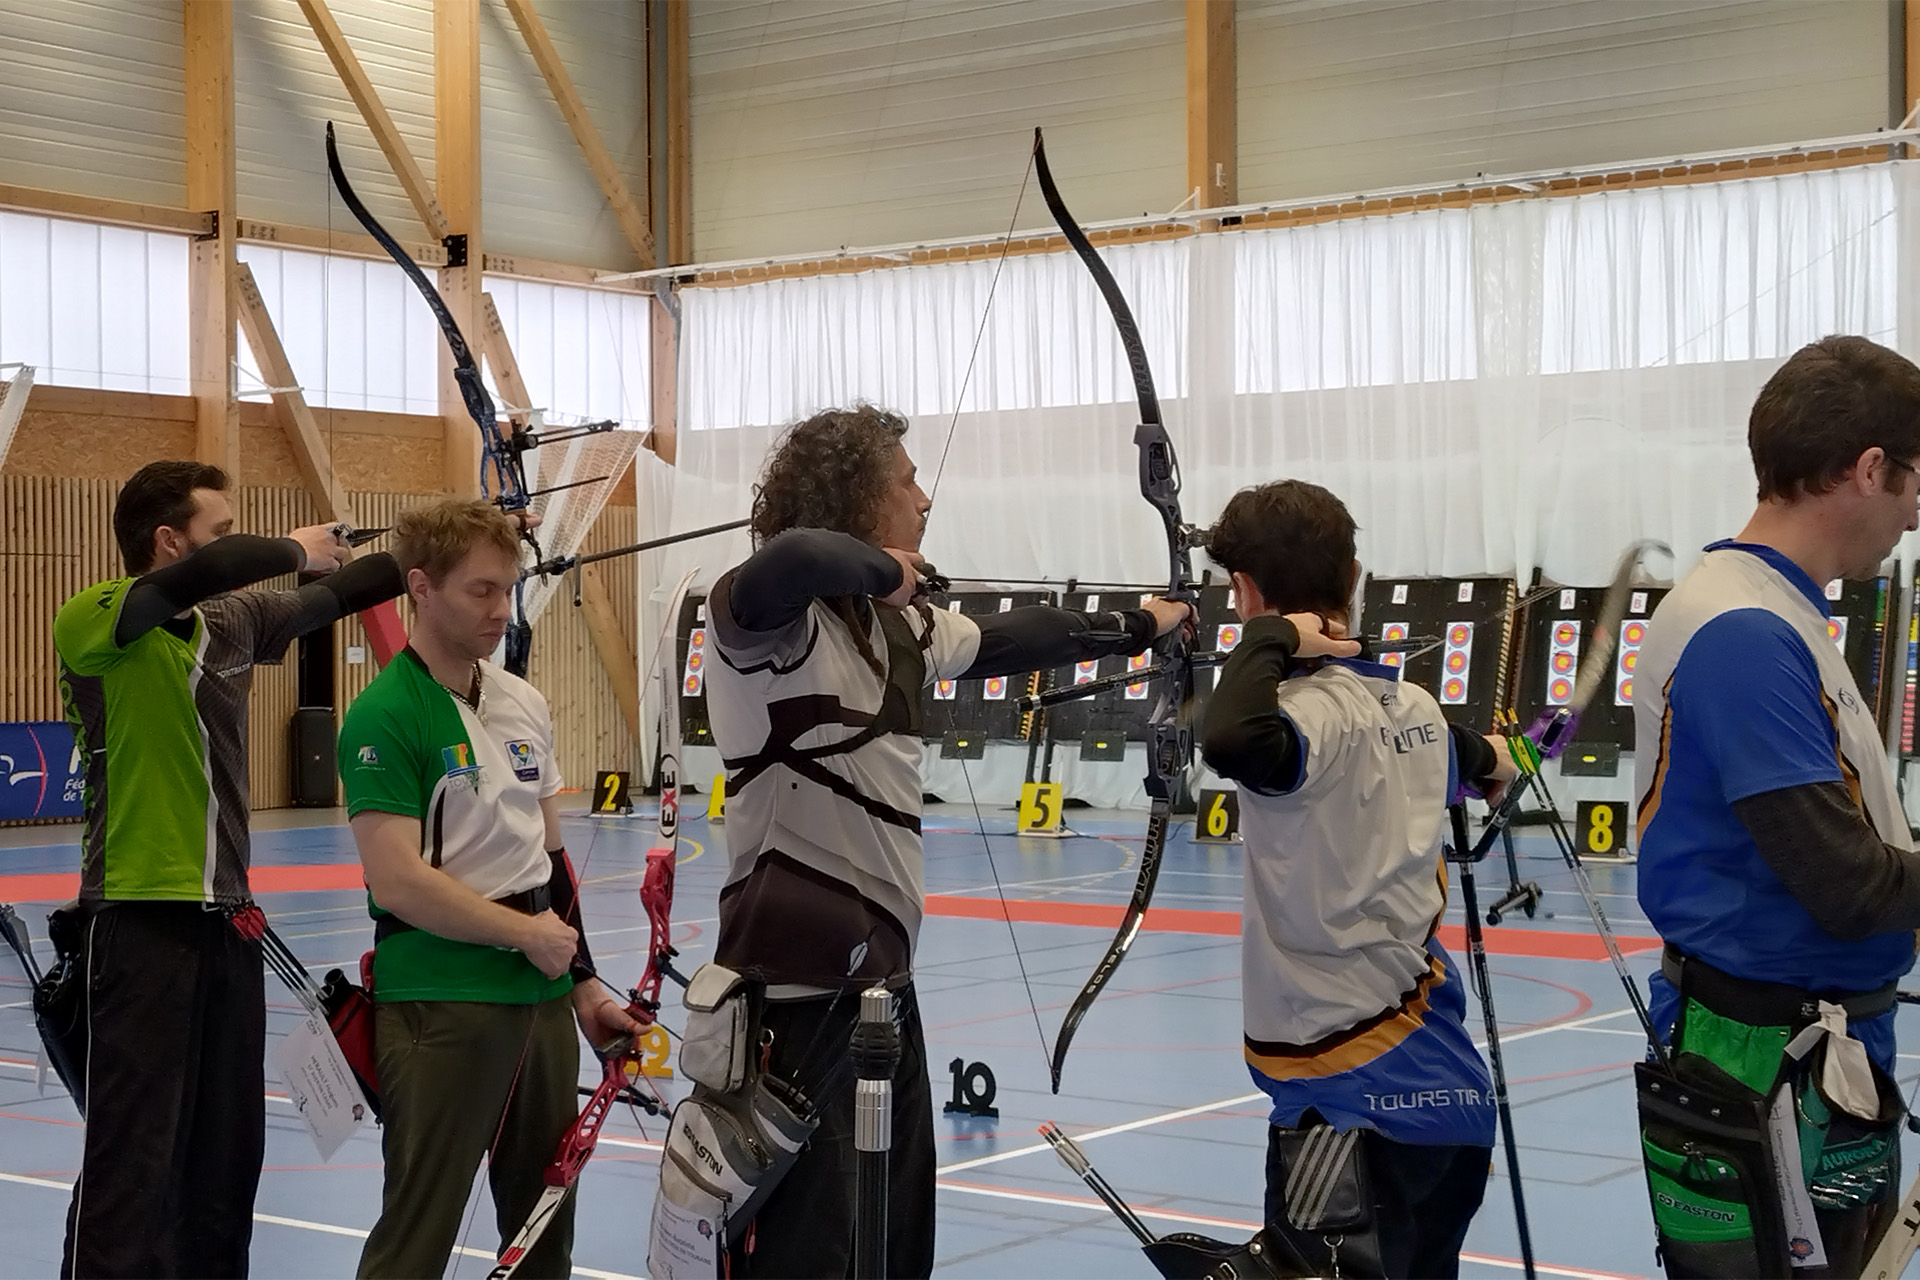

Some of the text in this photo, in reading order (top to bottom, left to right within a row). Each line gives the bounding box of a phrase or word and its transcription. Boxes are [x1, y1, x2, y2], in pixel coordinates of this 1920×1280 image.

[603, 773, 621, 811] 2
[660, 770, 679, 828] EXE
[1030, 788, 1052, 828] 5
[1207, 793, 1229, 837] 6
[1588, 804, 1614, 853] 8
[1086, 945, 1126, 995] VELOS
[640, 1025, 671, 1071] 9
[948, 1057, 997, 1110] 10
[1363, 1089, 1451, 1111] TOURS
[1454, 1088, 1481, 1106] TIR
[1674, 1200, 1736, 1223] EASTON
